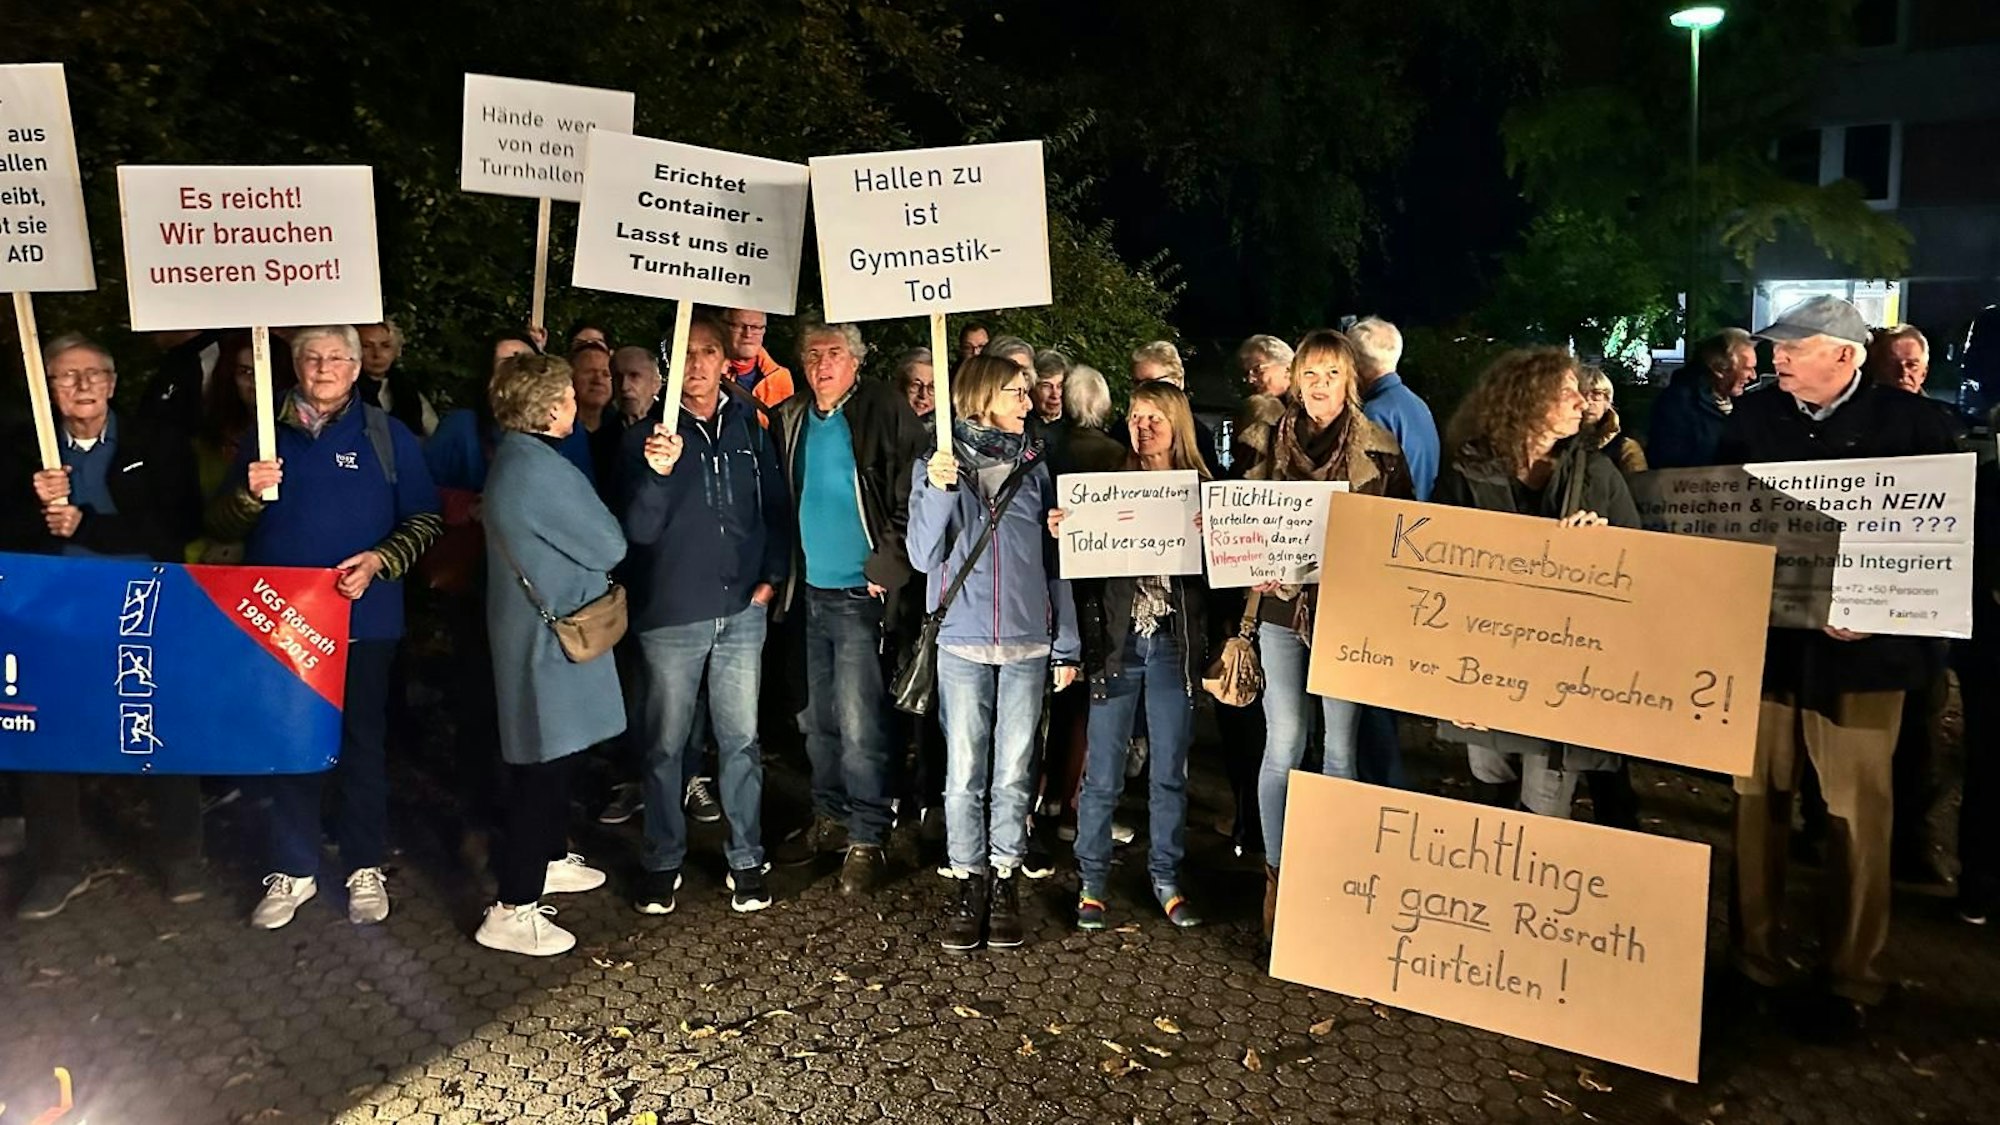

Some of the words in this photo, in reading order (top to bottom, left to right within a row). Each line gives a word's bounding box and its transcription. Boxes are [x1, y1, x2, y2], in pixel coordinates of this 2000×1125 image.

[483, 105, 543, 127] Hände
[8, 128, 46, 142] aus
[498, 138, 532, 154] von
[540, 140, 574, 157] den
[480, 157, 584, 184] Turnhallen
[654, 163, 747, 194] Erichtet
[854, 165, 943, 193] Hallen
[952, 166, 982, 185] zu
[179, 187, 212, 210] Es
[221, 186, 302, 210] reicht!
[638, 191, 750, 224] Container
[17, 216, 48, 234] sie
[904, 202, 939, 227] ist
[160, 222, 206, 246] Wir
[213, 221, 333, 245] brauchen
[616, 221, 681, 248] Lasst
[688, 236, 729, 254] uns
[736, 241, 770, 260] die
[7, 245, 44, 263] AfD
[850, 238, 1002, 275] Gymnastik-
[150, 260, 256, 284] unseren
[264, 258, 341, 287] Sport!
[630, 253, 751, 287] Turnhallen
[904, 277, 952, 302] Tod
[1069, 482, 1190, 505] Stadtverwaltung
[1673, 479, 1740, 494] Weitere
[1747, 475, 1867, 493] Flüchtlinge
[1875, 472, 1896, 488] in
[1749, 498, 1763, 513] &
[1769, 496, 1872, 513] Forsbach
[1882, 492, 1947, 510] NEIN
[1262, 515, 1283, 530] auf
[1750, 519, 1779, 534] die
[1787, 517, 1848, 533] Heide
[1857, 517, 1901, 532] rein
[1391, 513, 1633, 593] Kammerbroich
[1814, 552, 1854, 568] halb
[1860, 553, 1953, 573] Integriert
[253, 577, 286, 612] VGS
[280, 605, 336, 657] Rösrath
[1406, 586, 1449, 630] 72
[1466, 615, 1604, 652] versprochen
[236, 597, 276, 634] 1985
[278, 634, 320, 670] 2015
[1336, 637, 1394, 668] schon
[1408, 657, 1440, 677] vor
[1446, 656, 1529, 701] Bezug
[1545, 666, 1674, 712] gebrochen
[1374, 806, 1610, 916] Flüchtlinge
[1343, 874, 1381, 915] auf
[1391, 887, 1491, 933] ganz
[1512, 902, 1647, 964] Rösrath
[1387, 935, 1543, 1001] fairteilen
